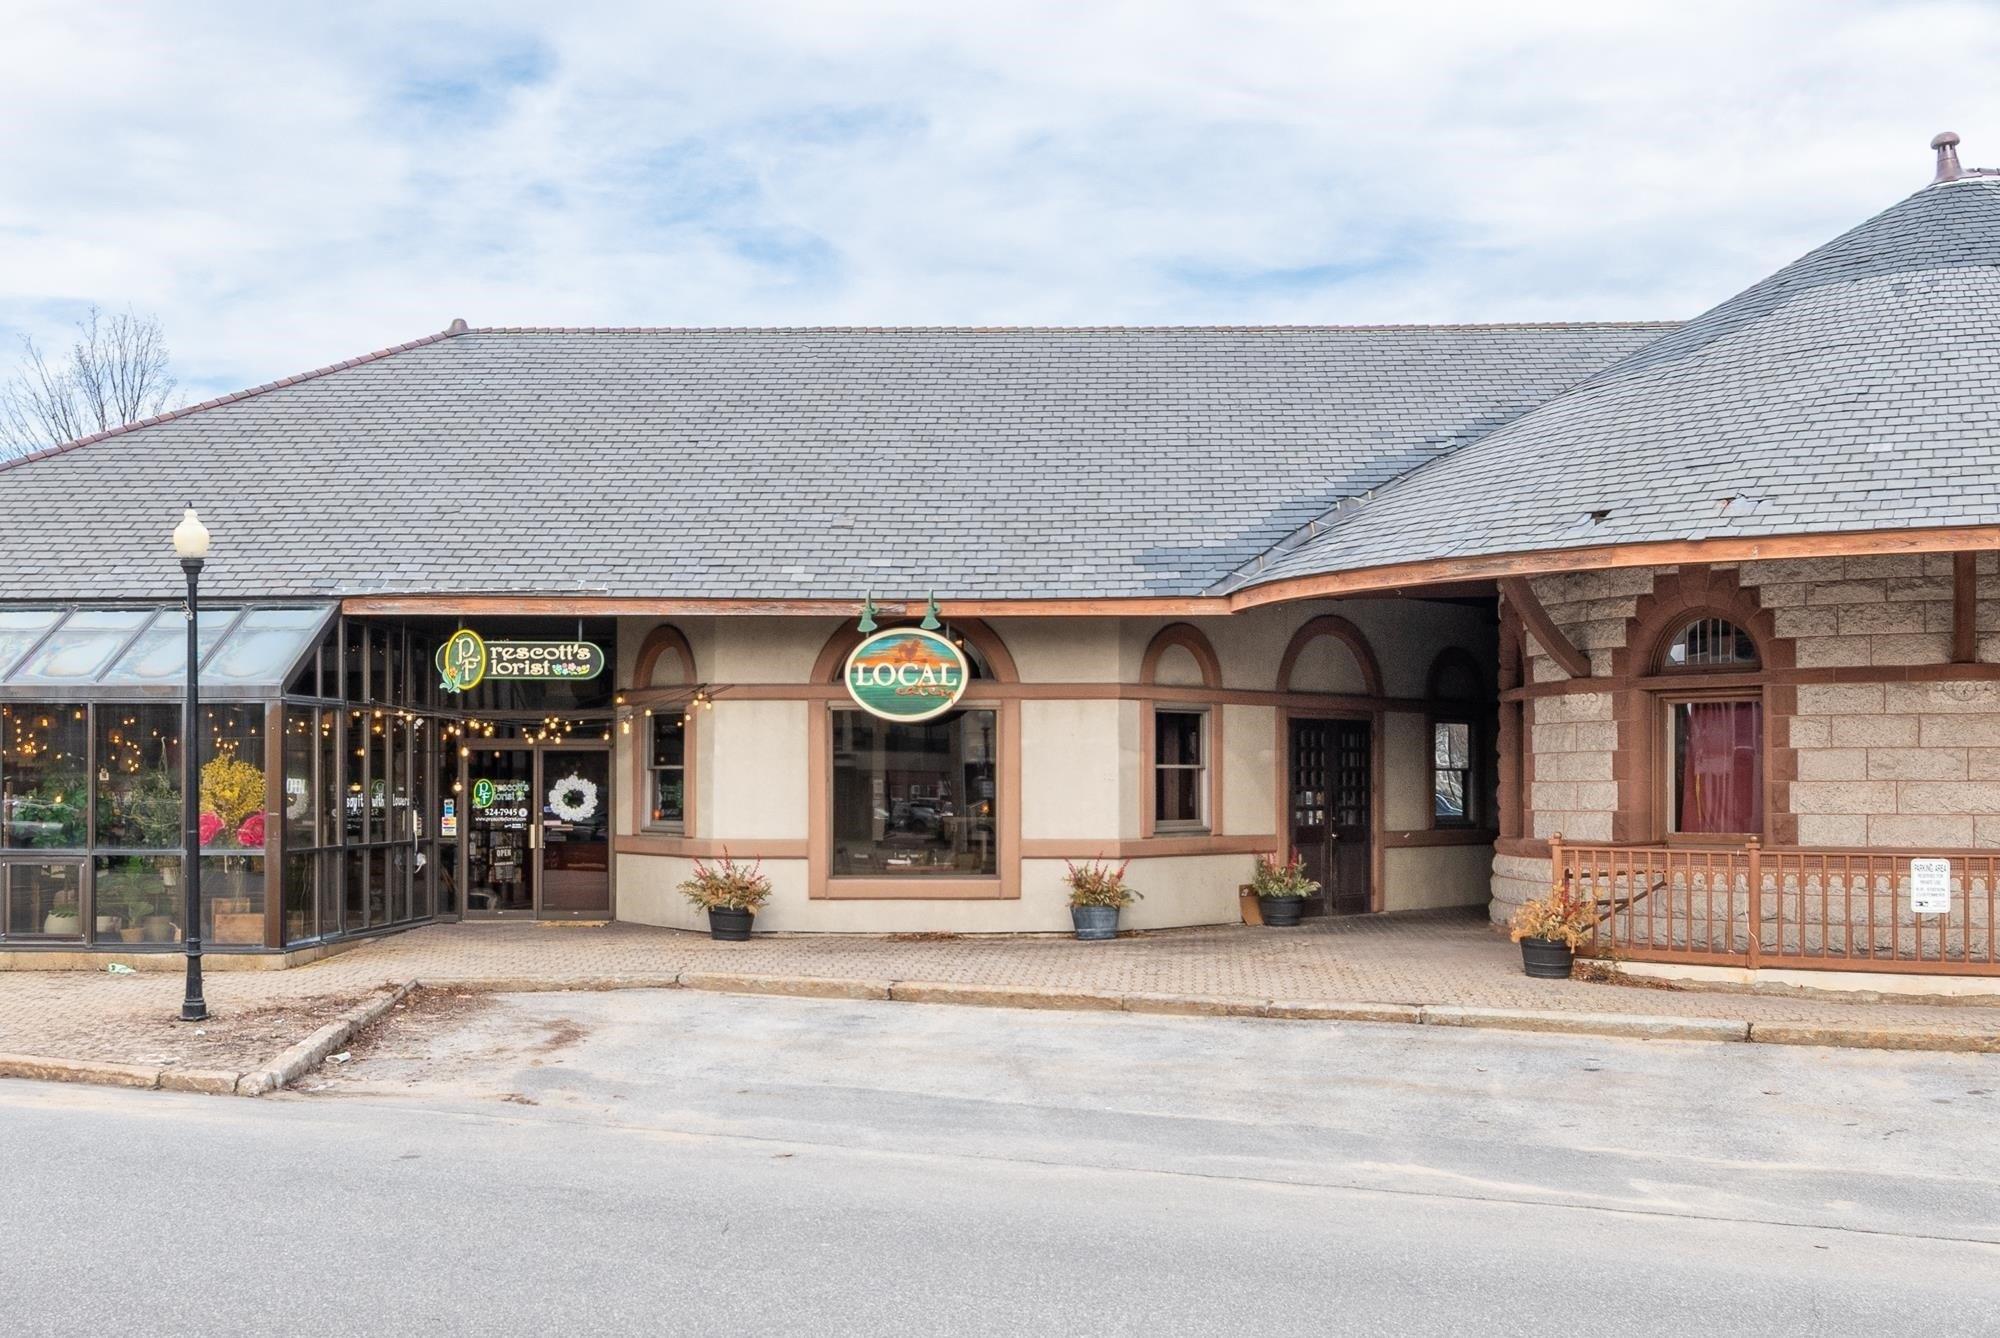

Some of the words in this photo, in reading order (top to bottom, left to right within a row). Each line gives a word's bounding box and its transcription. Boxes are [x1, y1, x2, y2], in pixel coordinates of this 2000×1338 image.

[855, 662, 957, 687] LOCAL
[392, 793, 410, 807] lowers
[496, 849, 512, 858] OPEN
